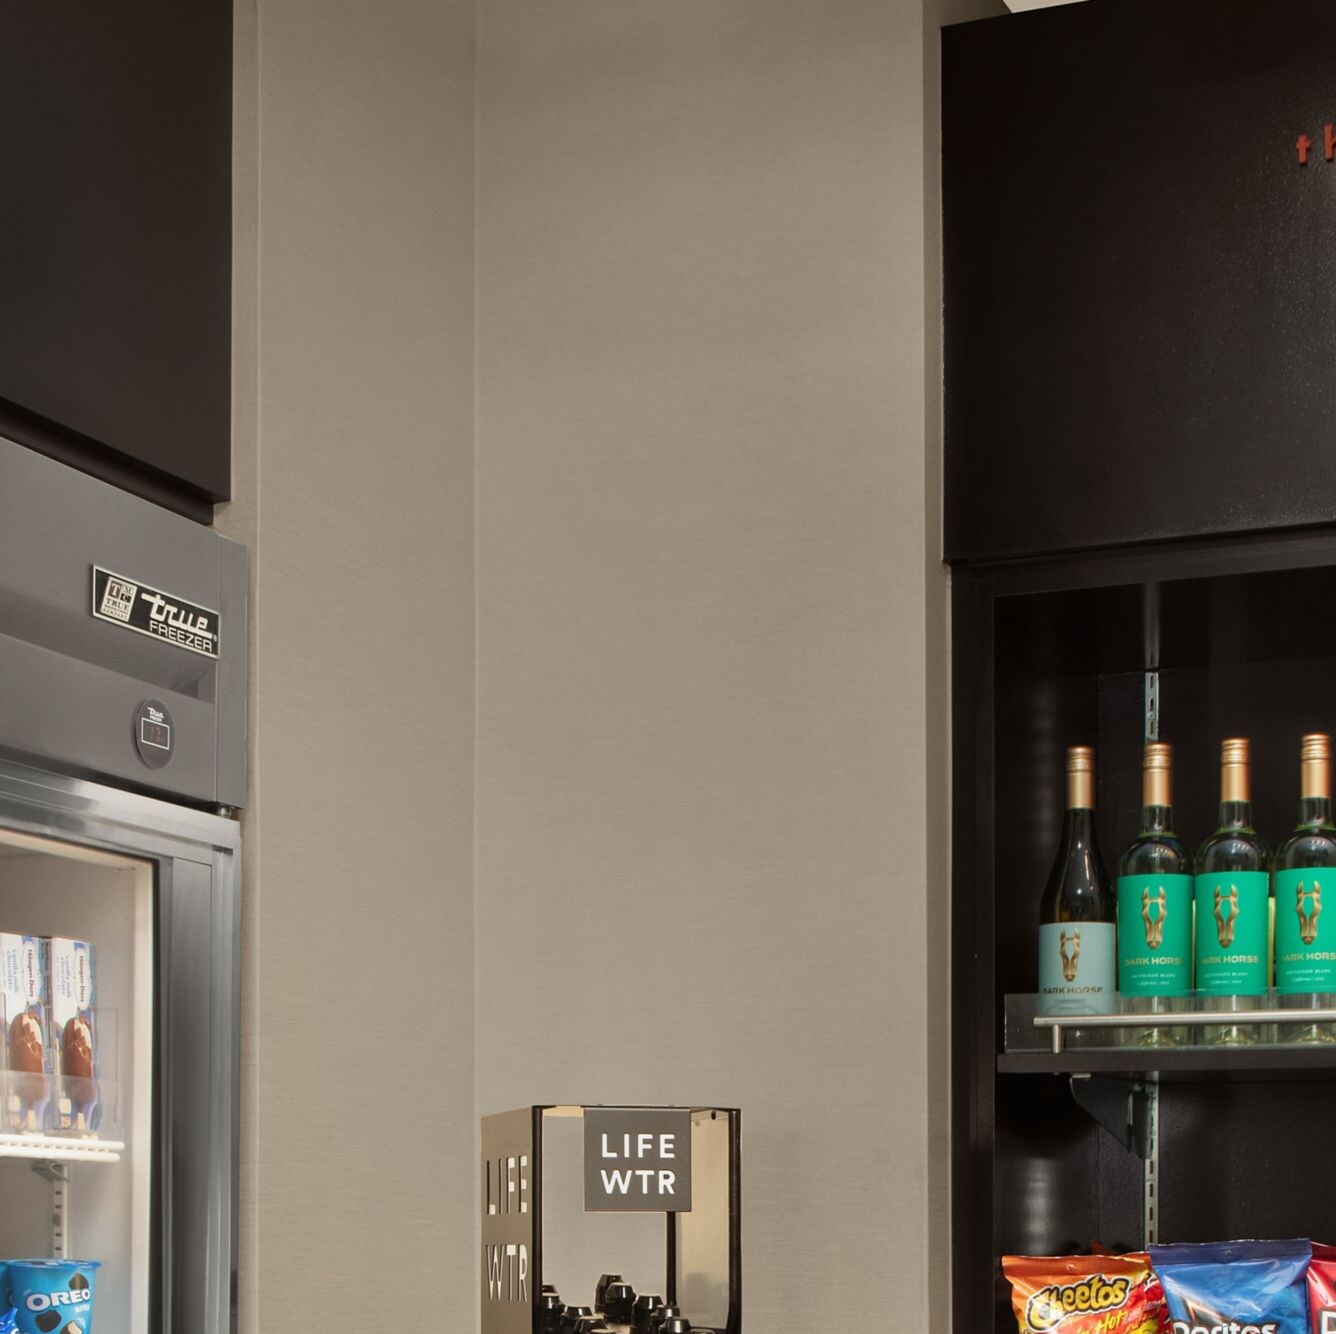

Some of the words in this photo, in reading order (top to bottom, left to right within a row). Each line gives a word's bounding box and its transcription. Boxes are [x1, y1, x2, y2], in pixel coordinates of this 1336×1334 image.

[106, 598, 129, 611] TRUE
[149, 620, 213, 654] FREEZER
[1151, 957, 1184, 966] HORSE
[1223, 955, 1260, 964] HORSE
[1306, 952, 1336, 961] HORS
[602, 1134, 675, 1158] LIFE
[486, 1155, 528, 1216] LIFE
[601, 1170, 676, 1194] WTR
[486, 1244, 528, 1303] WTR
[26, 1289, 91, 1312] OREO
[1028, 1274, 1129, 1332] Cheetos
